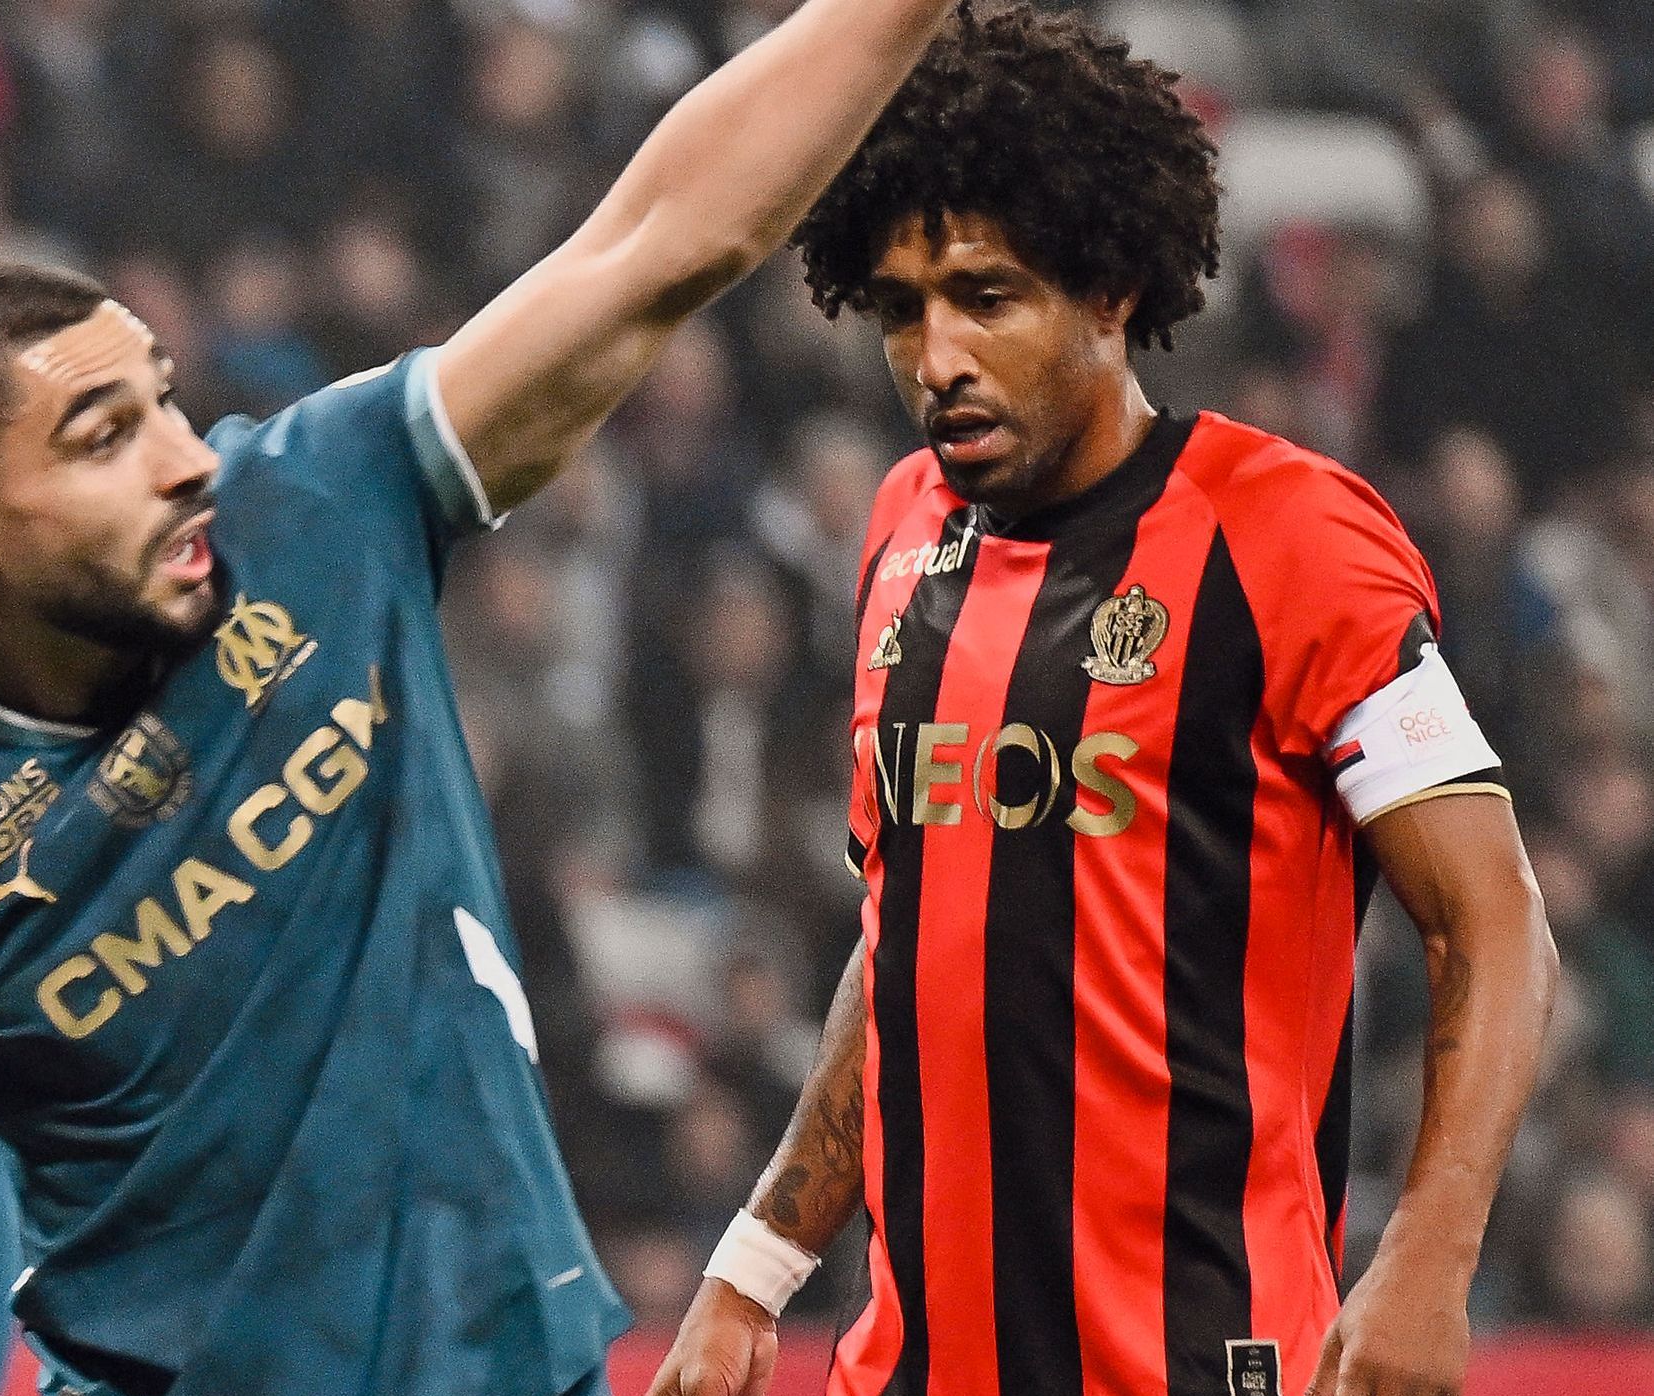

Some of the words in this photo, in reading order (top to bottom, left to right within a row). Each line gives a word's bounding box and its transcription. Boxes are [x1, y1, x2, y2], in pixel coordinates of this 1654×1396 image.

[879, 526, 975, 582] actual
[855, 722, 1139, 838] NEOS
[36, 857, 256, 1040] CMA
